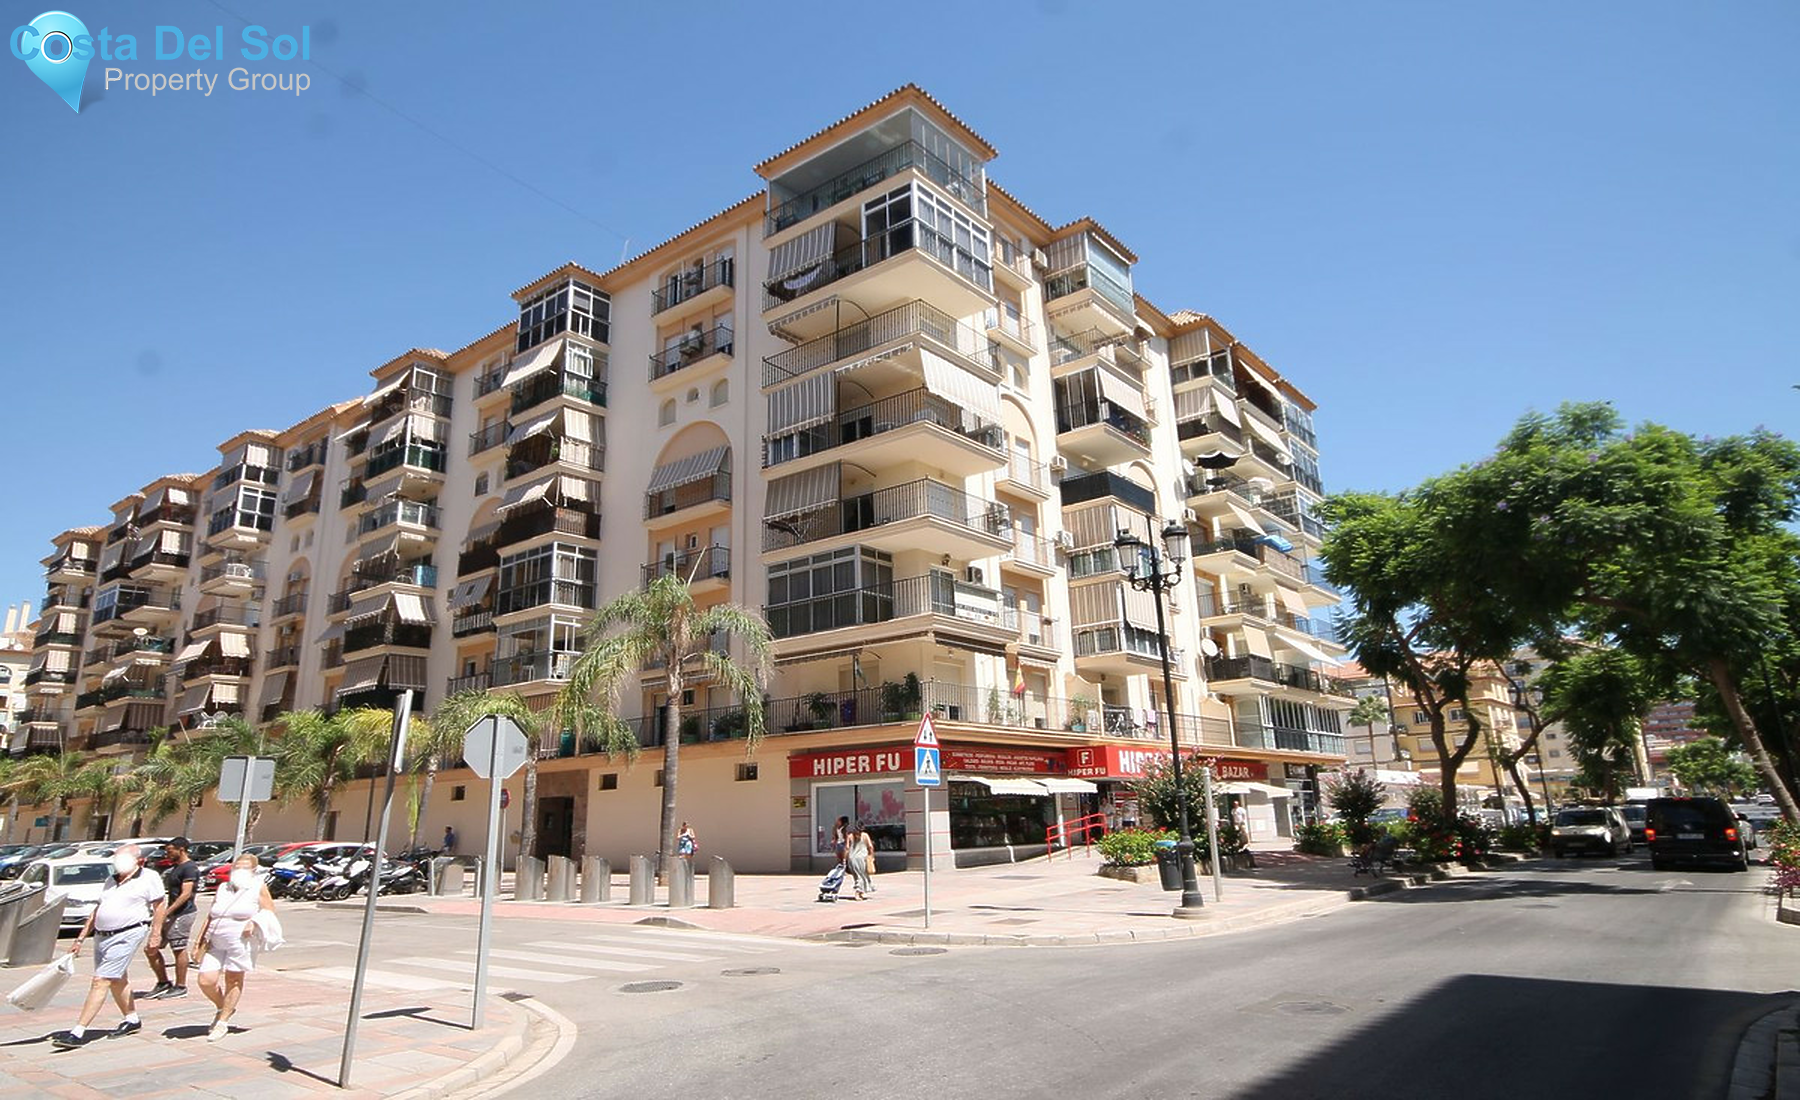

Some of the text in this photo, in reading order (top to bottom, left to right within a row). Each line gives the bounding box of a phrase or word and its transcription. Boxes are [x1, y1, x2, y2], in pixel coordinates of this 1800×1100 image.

[813, 752, 901, 776] HIPER FU
[1080, 751, 1090, 764] F
[1067, 766, 1106, 776] HIPER FU
[1222, 765, 1250, 779] BAZAR
